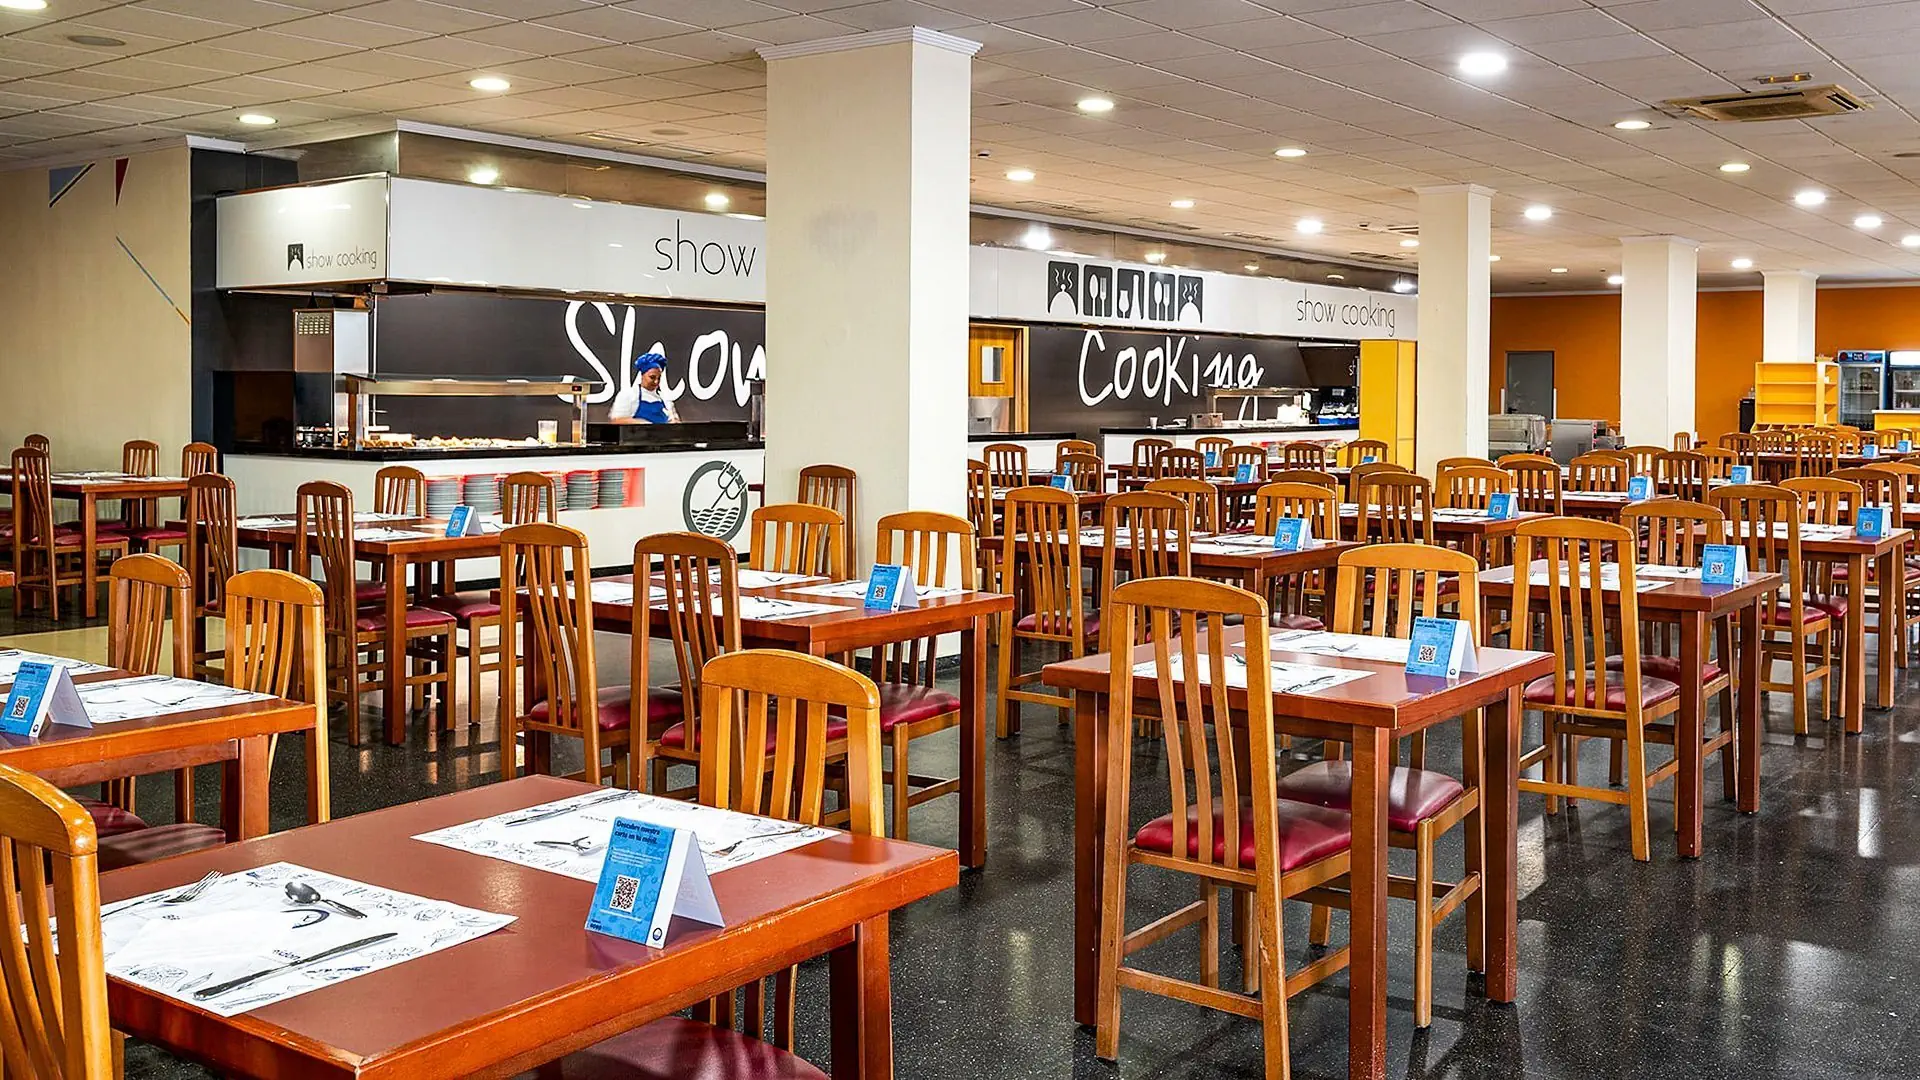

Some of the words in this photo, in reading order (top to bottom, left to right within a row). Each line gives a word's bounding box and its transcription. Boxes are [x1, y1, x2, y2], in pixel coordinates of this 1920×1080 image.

[306, 247, 334, 269] show
[336, 244, 377, 270] cooking
[655, 218, 756, 277] show
[1296, 287, 1337, 323] show
[1341, 294, 1396, 338] cooking
